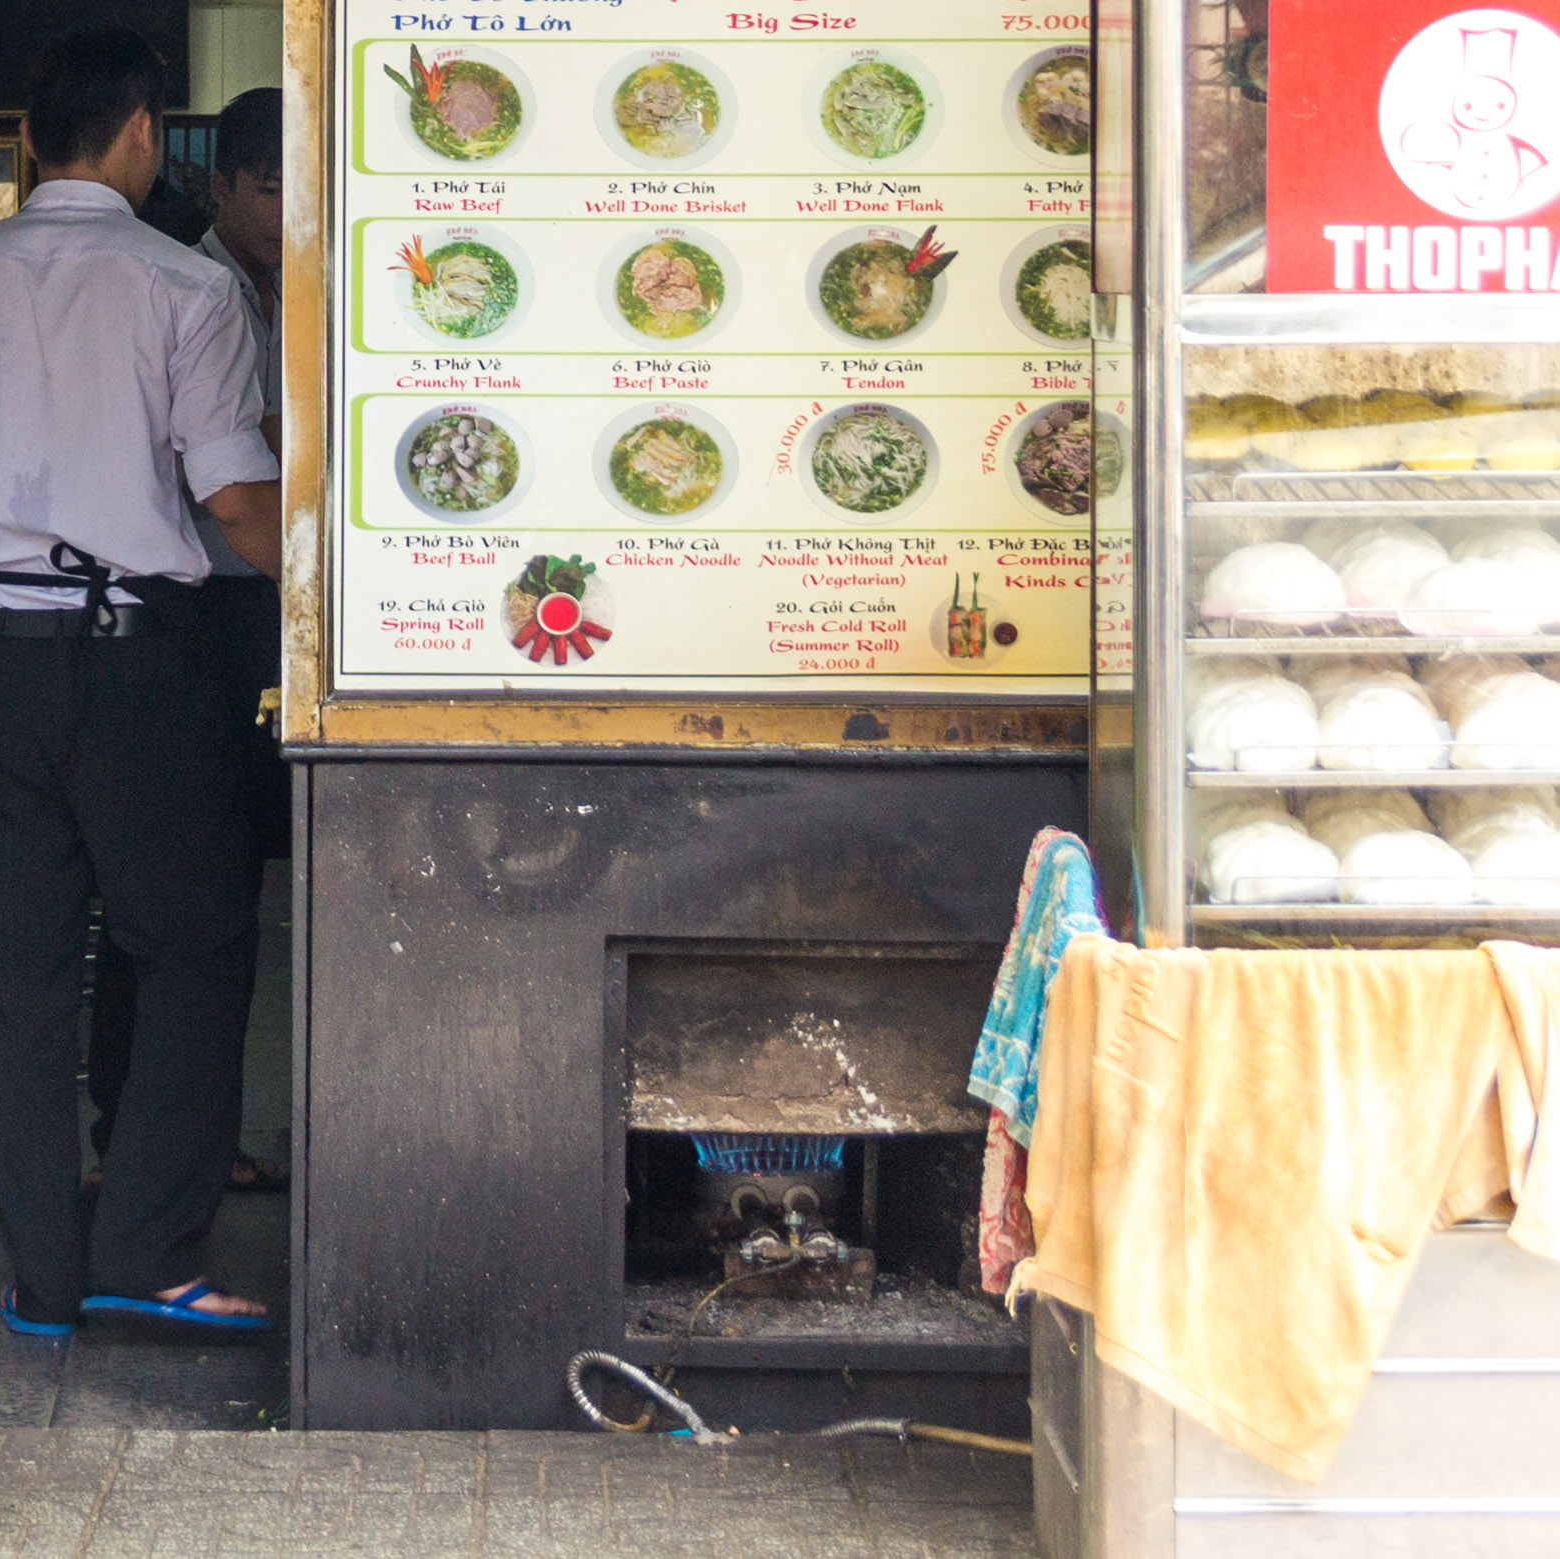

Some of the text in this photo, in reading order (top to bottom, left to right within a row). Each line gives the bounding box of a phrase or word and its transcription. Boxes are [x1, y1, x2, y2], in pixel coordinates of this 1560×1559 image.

[391, 12, 856, 34] Phở Tô Lớn Big Size
[433, 181, 505, 193] Phở Tái
[631, 182, 715, 194] Phở Chín
[836, 182, 921, 197] Phở Nạm
[1046, 181, 1084, 193] Phở
[415, 199, 501, 214] Raw Beef
[585, 200, 746, 213] Well Done Brisket
[796, 199, 943, 212] Well Done Flank
[1028, 199, 1072, 215] Fatty
[1324, 225, 1560, 290] THOPH
[435, 359, 501, 370] Phở Vè
[636, 360, 711, 373] Phở Giò
[842, 360, 923, 373] Phở Gân
[1045, 360, 1083, 372] Phở
[396, 376, 521, 390] Crunchy Flank
[614, 376, 708, 391] Beef Paste
[842, 376, 905, 389] Tendon
[1032, 376, 1076, 389] Bible
[405, 536, 519, 548] Phở Bò Viên
[648, 538, 719, 551] Phở Gà
[795, 537, 936, 553] Phở Không Thịt
[988, 538, 1064, 554] Phở Đặc
[413, 552, 495, 567] Beef Ball
[605, 553, 740, 567] Chicken Noodle
[758, 553, 948, 568] Noodle Without Meat
[802, 573, 906, 589] (Vegetarian)
[1005, 574, 1066, 589] Kinds
[451, 600, 485, 613] Giò
[381, 618, 484, 633] Spring Roll
[767, 619, 906, 633] Fresh Cold Roll
[394, 637, 455, 650] 60.000
[769, 639, 900, 653] (Summer Roll)
[799, 659, 860, 670] 24.000
